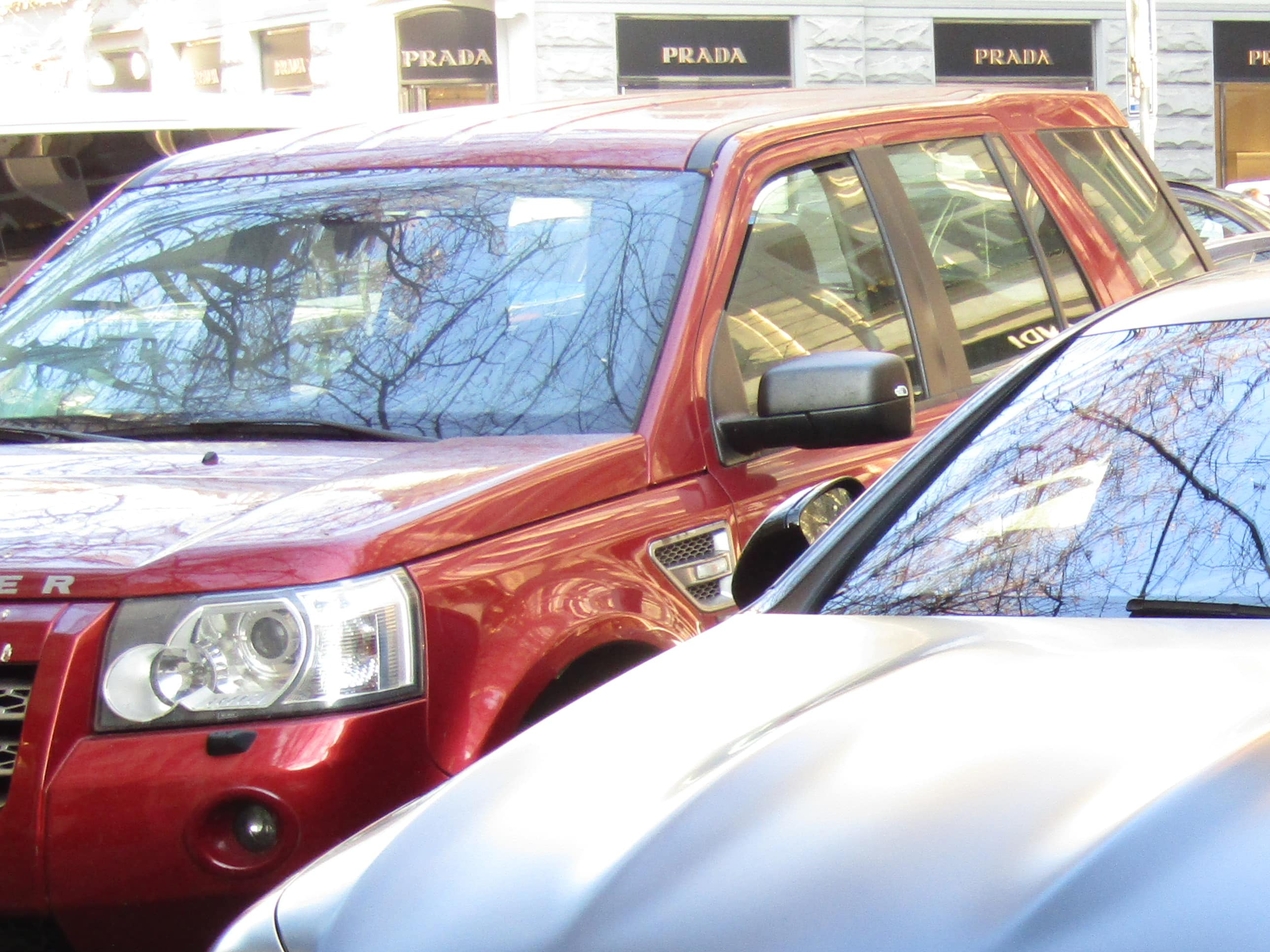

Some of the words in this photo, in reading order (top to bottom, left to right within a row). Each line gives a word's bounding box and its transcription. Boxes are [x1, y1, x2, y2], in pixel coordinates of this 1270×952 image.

[402, 48, 492, 68] PRADA
[662, 46, 748, 64] PRADA
[974, 48, 1054, 66] PRADA
